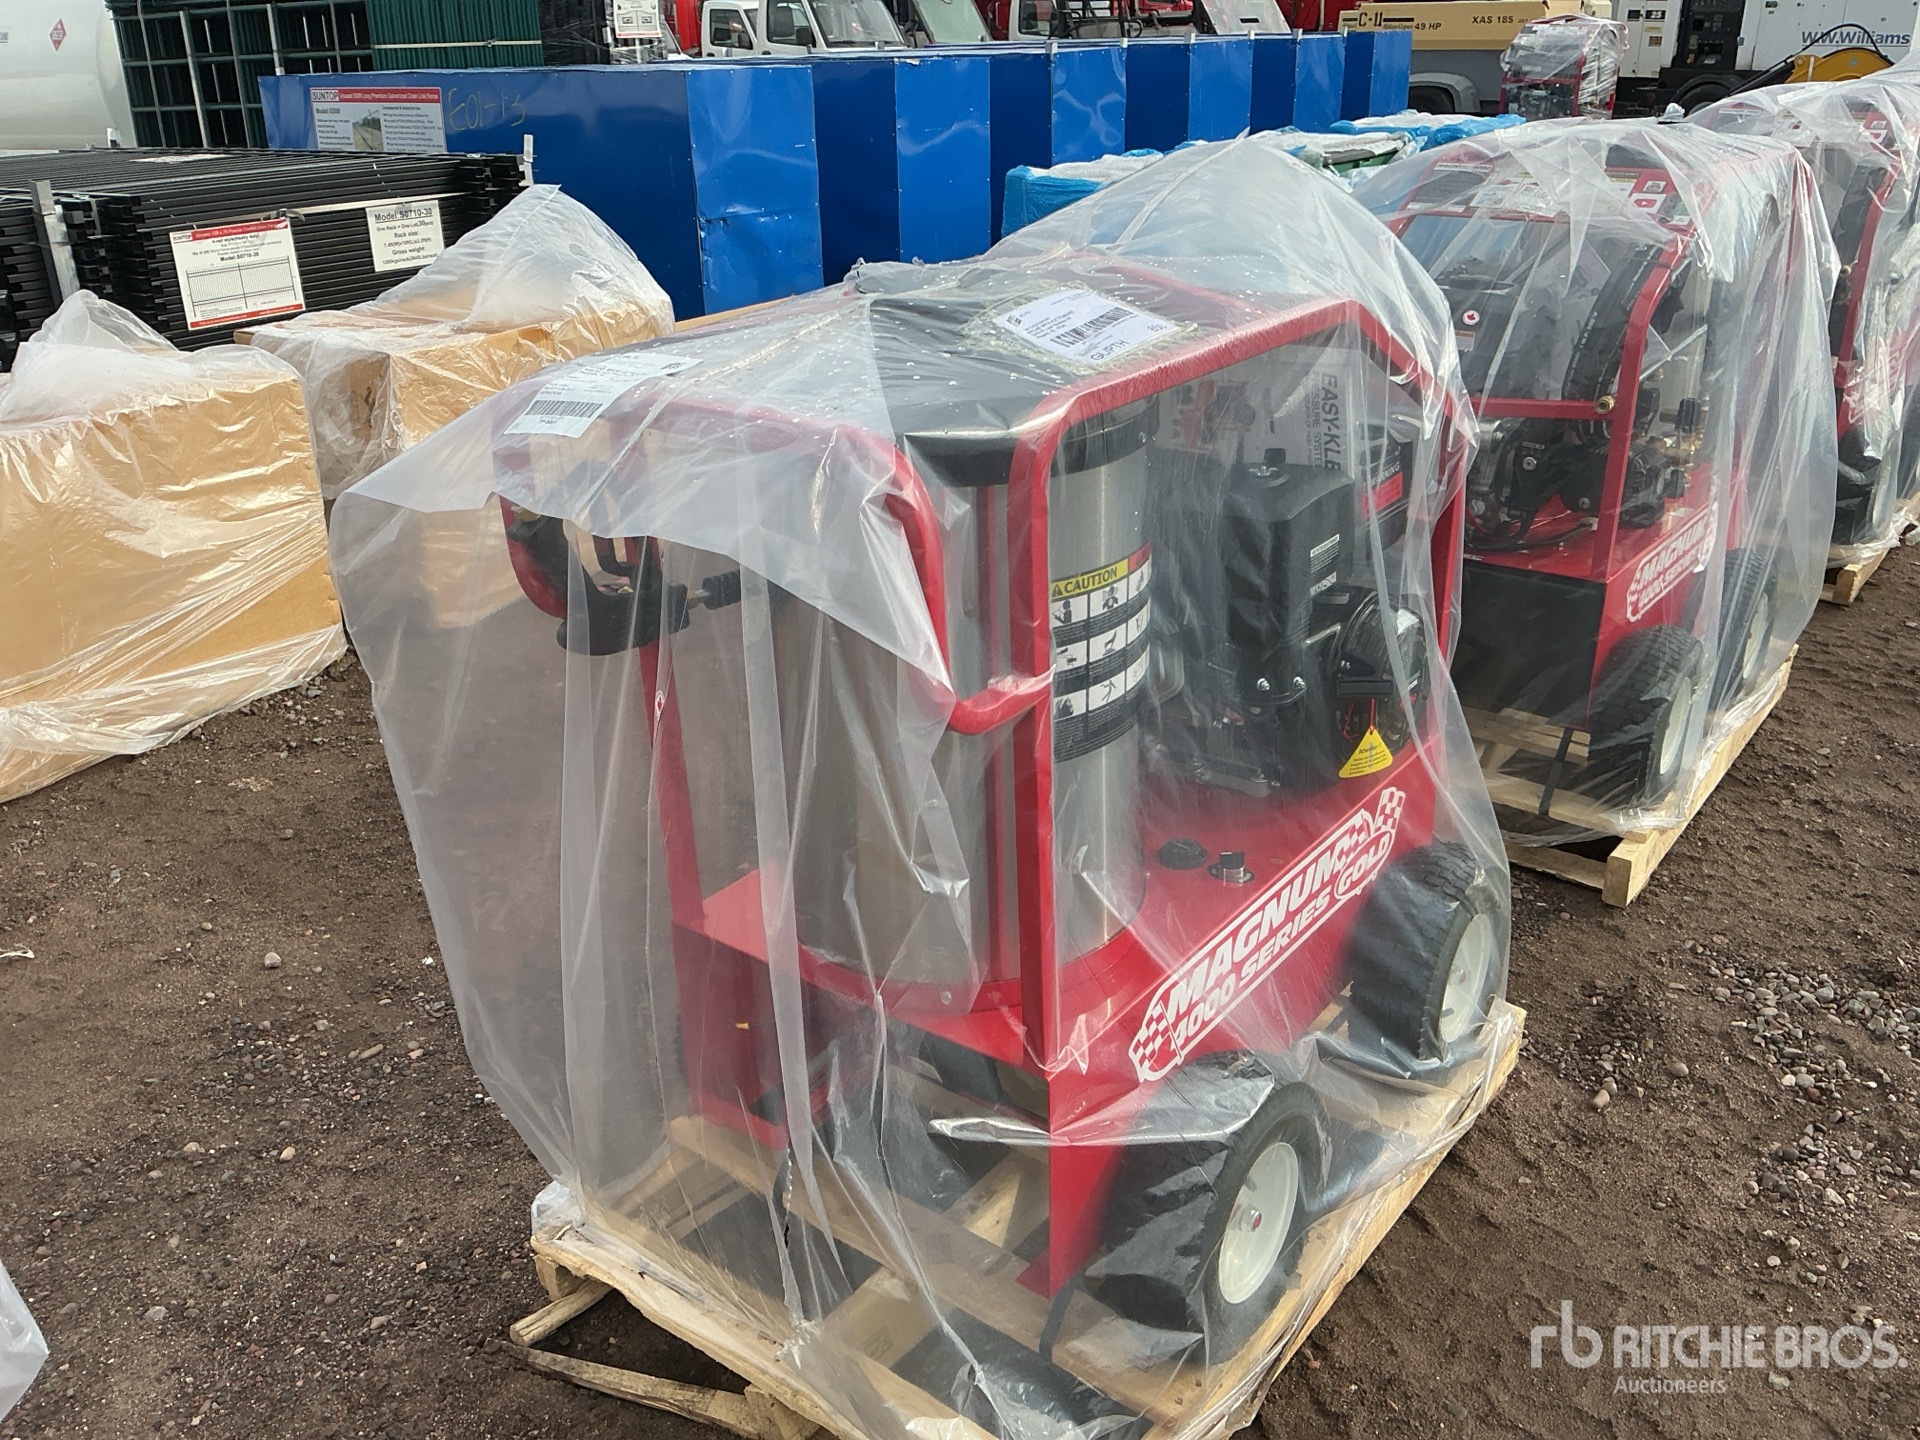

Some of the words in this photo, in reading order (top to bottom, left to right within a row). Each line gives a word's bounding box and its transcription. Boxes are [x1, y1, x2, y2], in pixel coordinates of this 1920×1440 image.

[1472, 15, 1493, 24] XAS
[1497, 15, 1514, 24] 185
[1650, 11, 1663, 19] 25
[1428, 22, 1442, 30] HP
[312, 91, 338, 101] SUNTOP
[1064, 566, 1118, 594] CAUTION
[1338, 832, 1391, 896] GOLD
[1167, 832, 1353, 1022] MAGNUM
[1171, 972, 1236, 1052] 4000
[1239, 885, 1330, 988] SERIES
